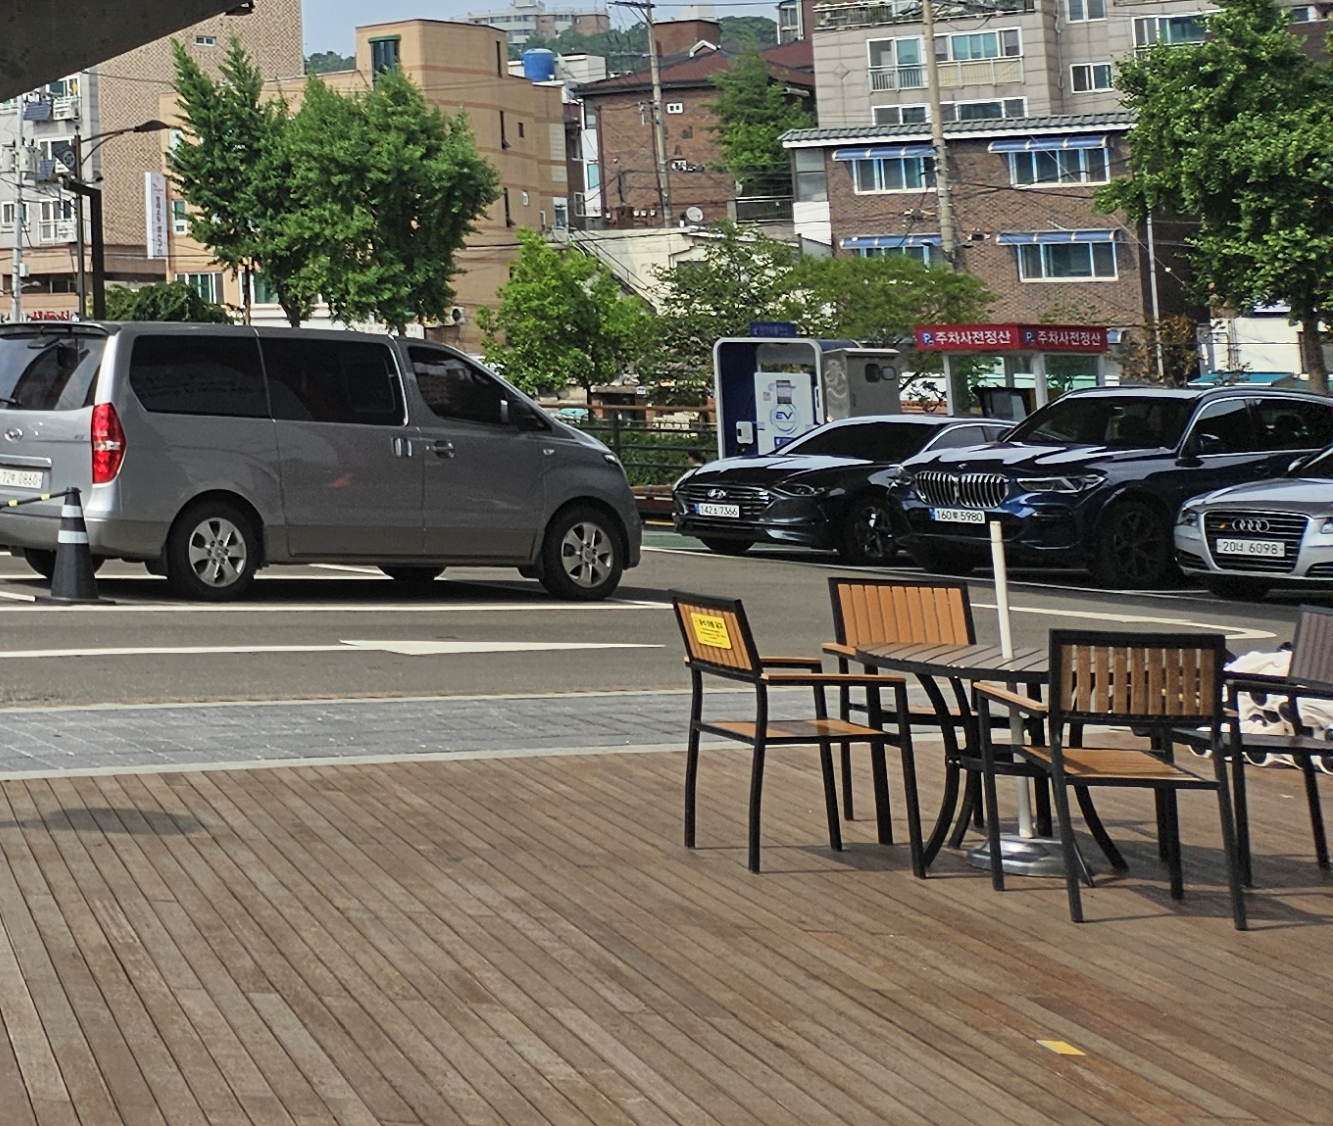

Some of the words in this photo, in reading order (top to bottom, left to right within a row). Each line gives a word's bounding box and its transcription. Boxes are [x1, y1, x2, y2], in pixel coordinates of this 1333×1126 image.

[935, 331, 1011, 345] 주차사전정산
[1038, 331, 1101, 346] 주차사전정산
[776, 412, 794, 421] EV
[960, 511, 983, 522] 5980
[1248, 544, 1278, 555] 6098
